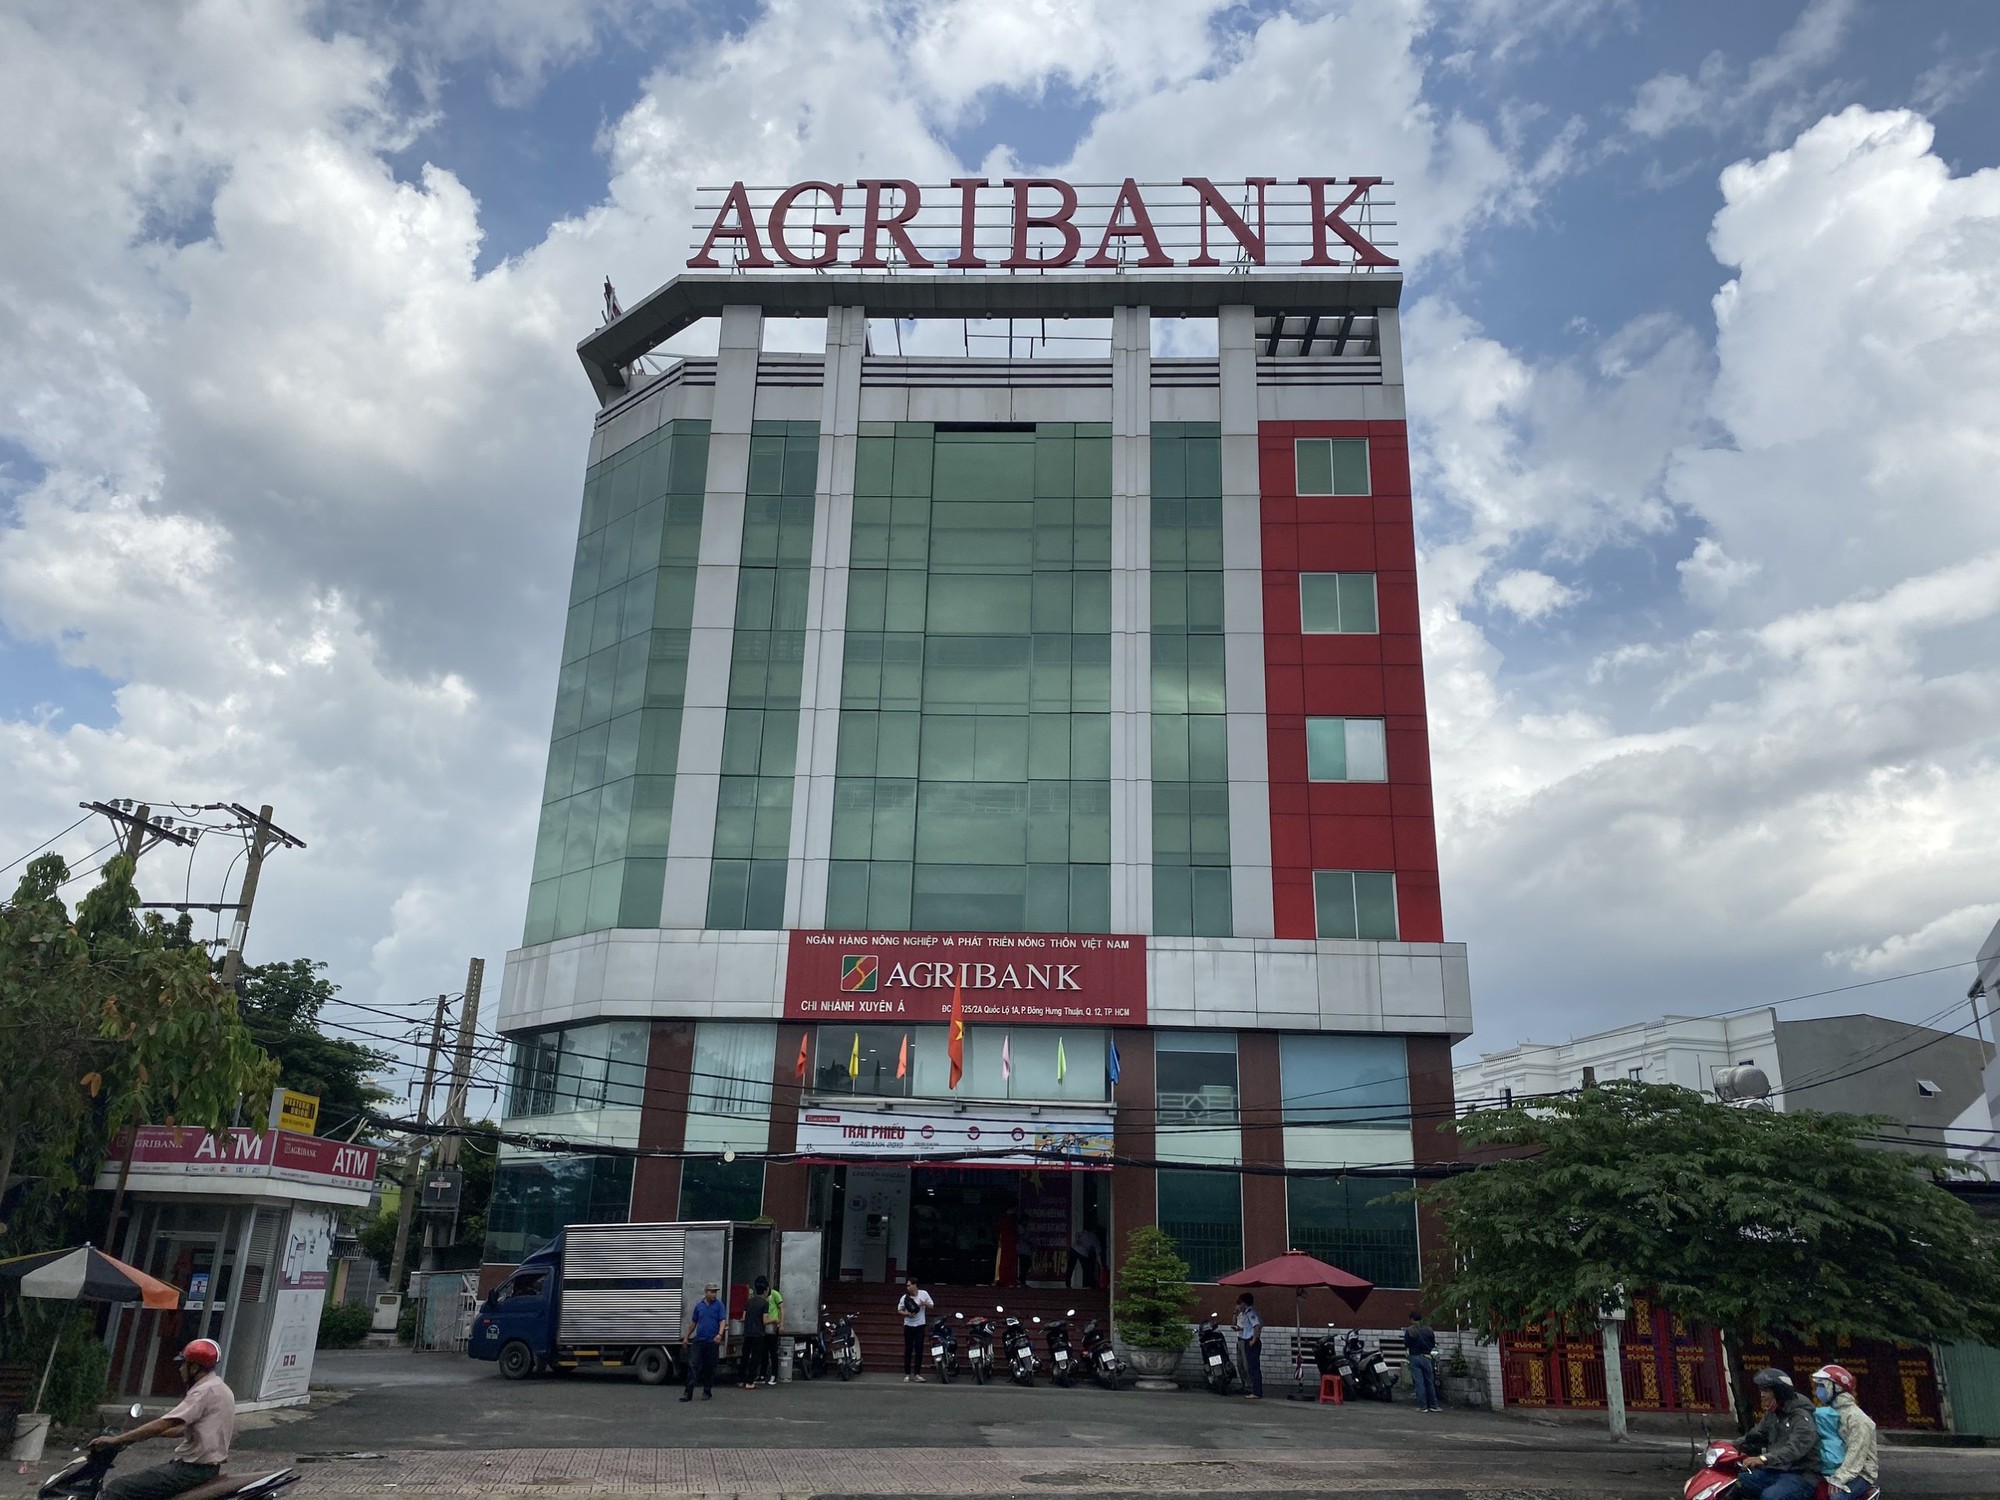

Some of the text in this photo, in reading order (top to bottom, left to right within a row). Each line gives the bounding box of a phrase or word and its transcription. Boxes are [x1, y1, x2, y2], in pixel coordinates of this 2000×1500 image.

[686, 176, 1399, 268] AGRIBANK
[806, 934, 1129, 950] NGÂN HÀNG NÔNG NGHIỆP VÀ PHÁT TRIỂN NÔNG THÔN VIỆT NAM
[884, 961, 1082, 990] AGRIBANK
[801, 999, 905, 1012] CHI NHÁNH XUYÊN Á
[984, 1005, 1000, 1014] Quốc
[1002, 1006, 1009, 1016] Lộ
[1045, 1007, 1062, 1017] Hưng
[1105, 1008, 1113, 1016] TP.
[134, 1138, 183, 1149] GRIBAN
[332, 1147, 368, 1176] ATM
